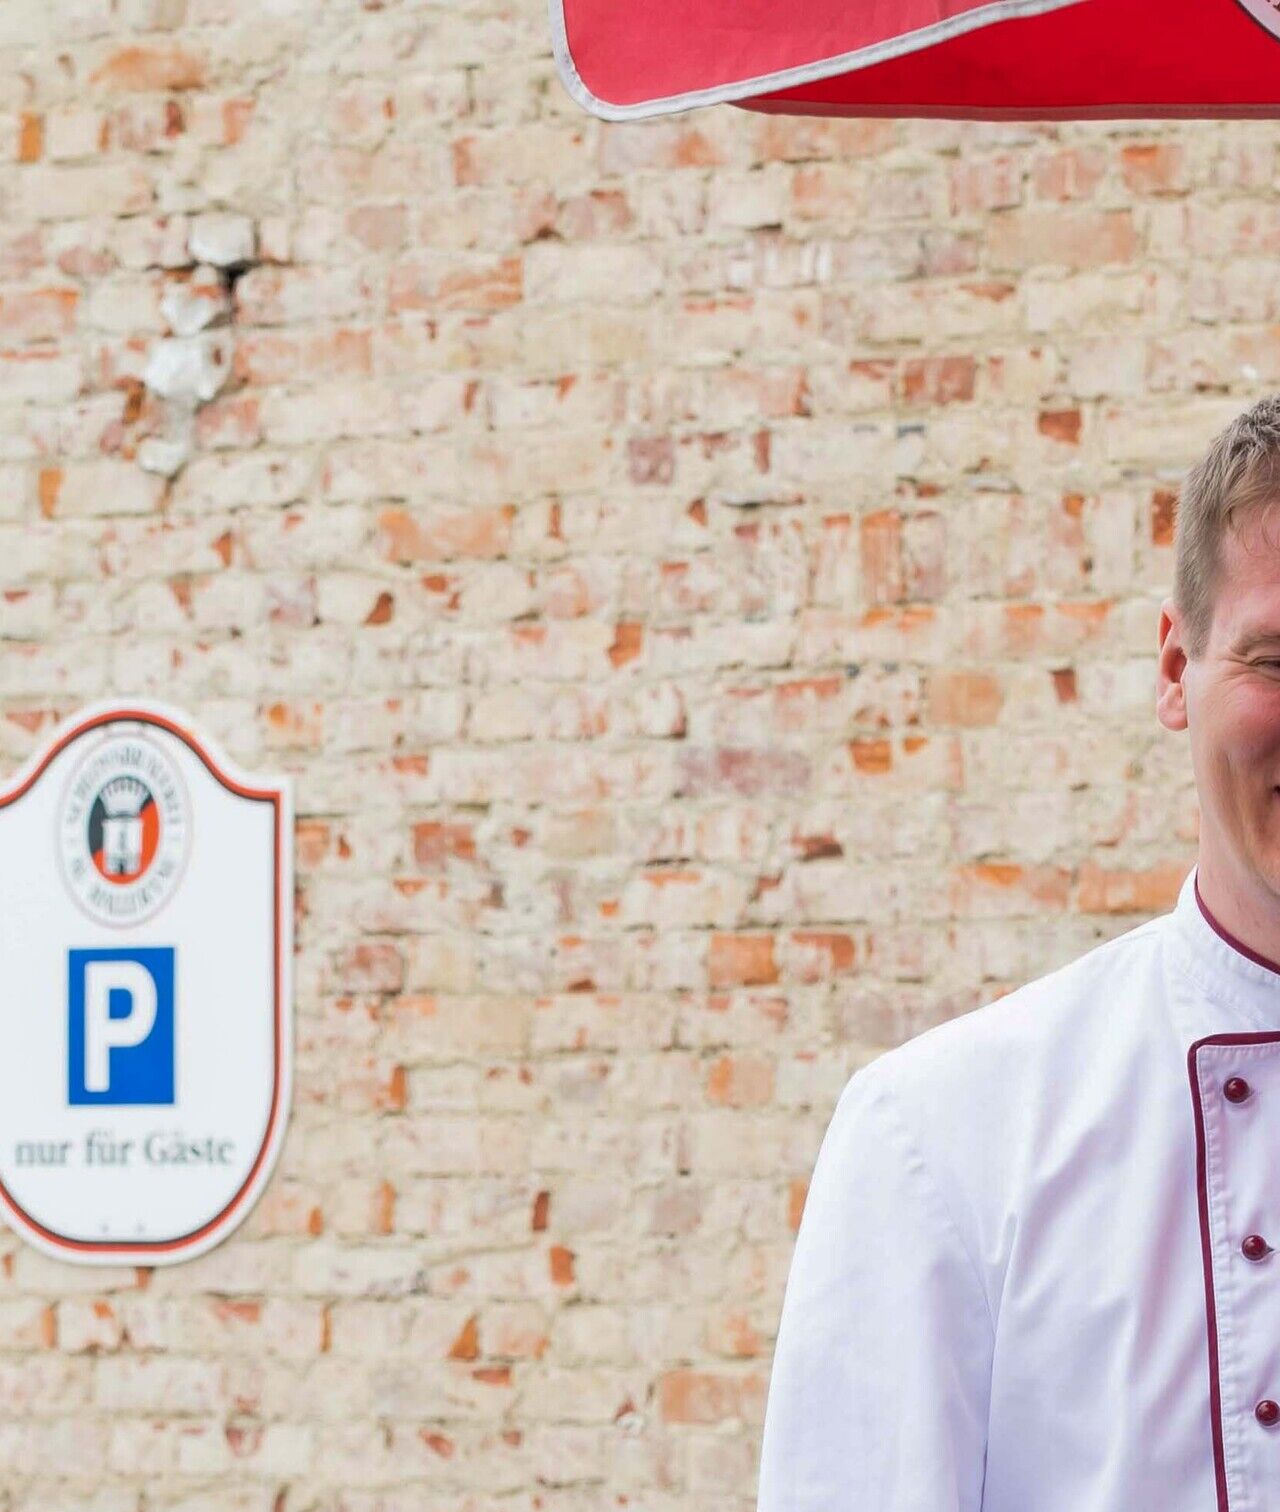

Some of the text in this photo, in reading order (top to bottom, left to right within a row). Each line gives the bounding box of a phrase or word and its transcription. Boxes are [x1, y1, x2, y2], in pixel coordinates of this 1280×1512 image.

[83, 959, 158, 1093] P
[15, 1128, 235, 1166] nur für Gäste
